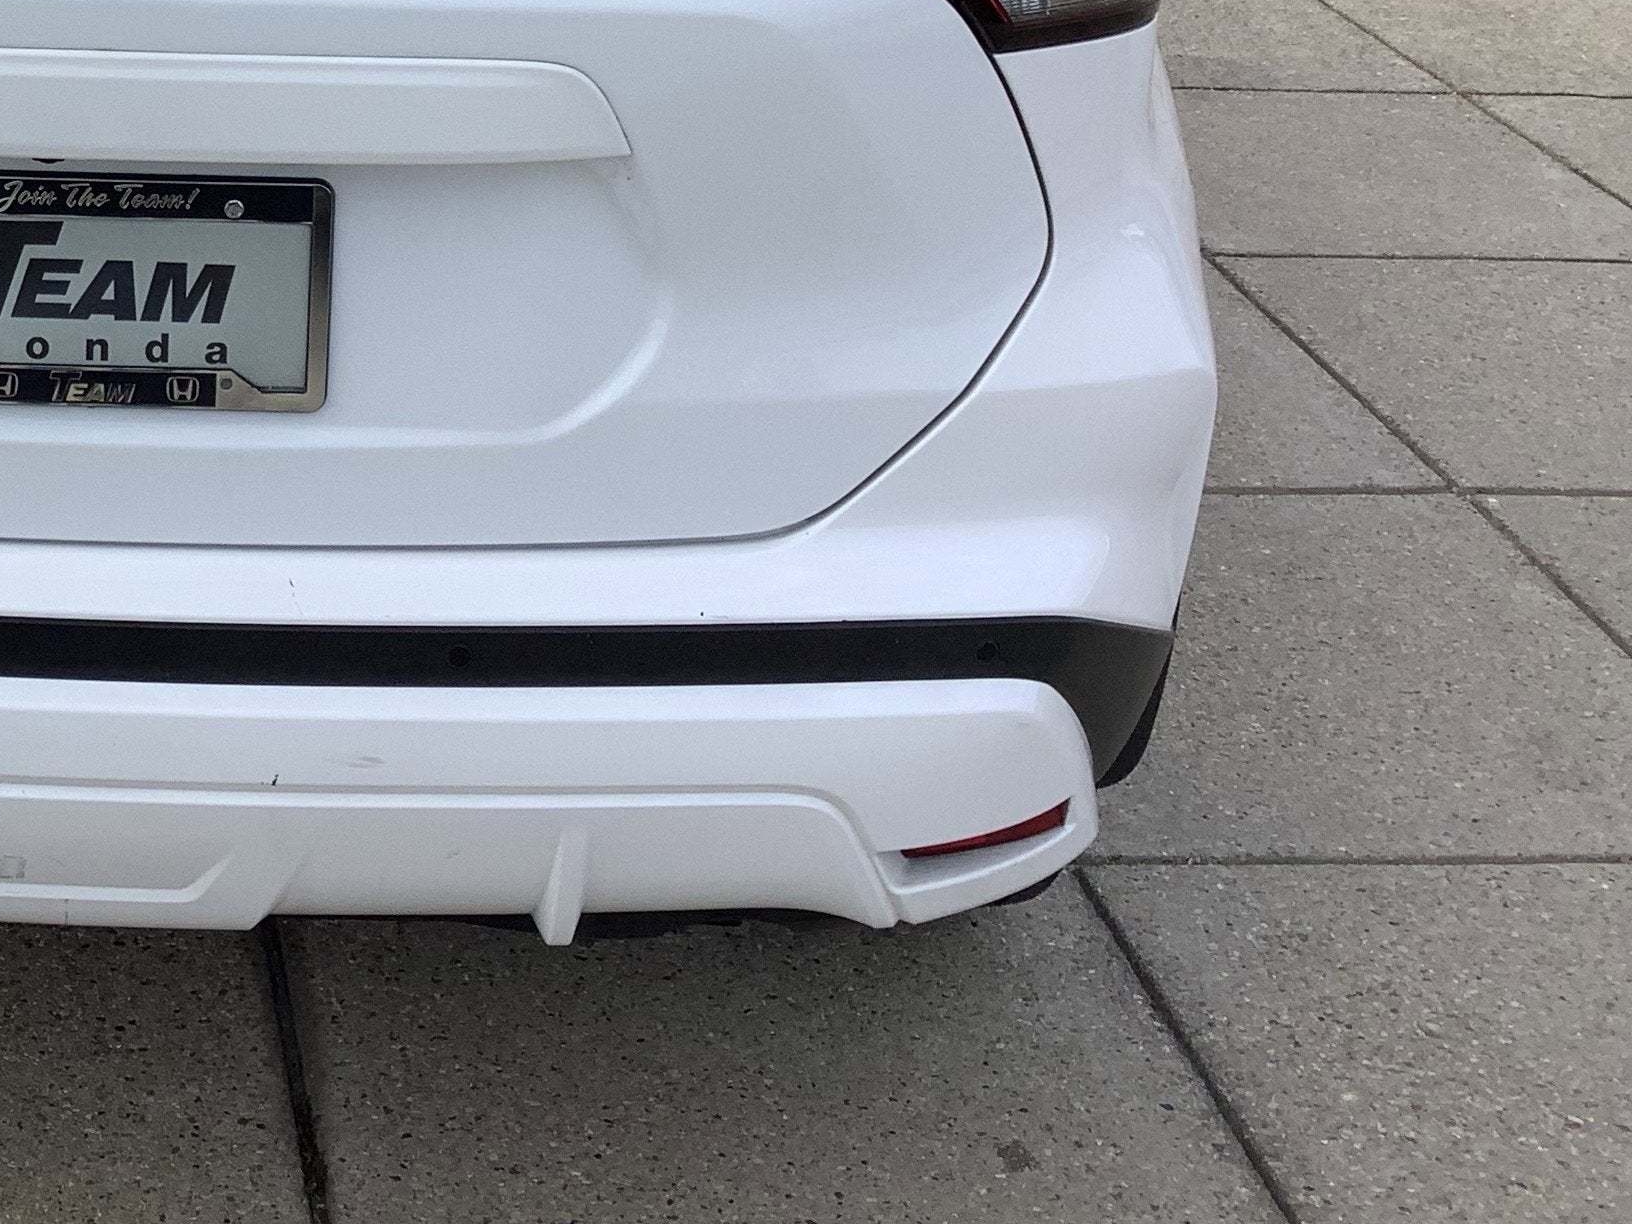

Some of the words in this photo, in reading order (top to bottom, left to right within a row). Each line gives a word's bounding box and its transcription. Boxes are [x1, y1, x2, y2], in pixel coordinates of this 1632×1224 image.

[60, 183, 110, 208] The
[114, 184, 200, 210] Team!
[49, 370, 136, 404] TEAM
